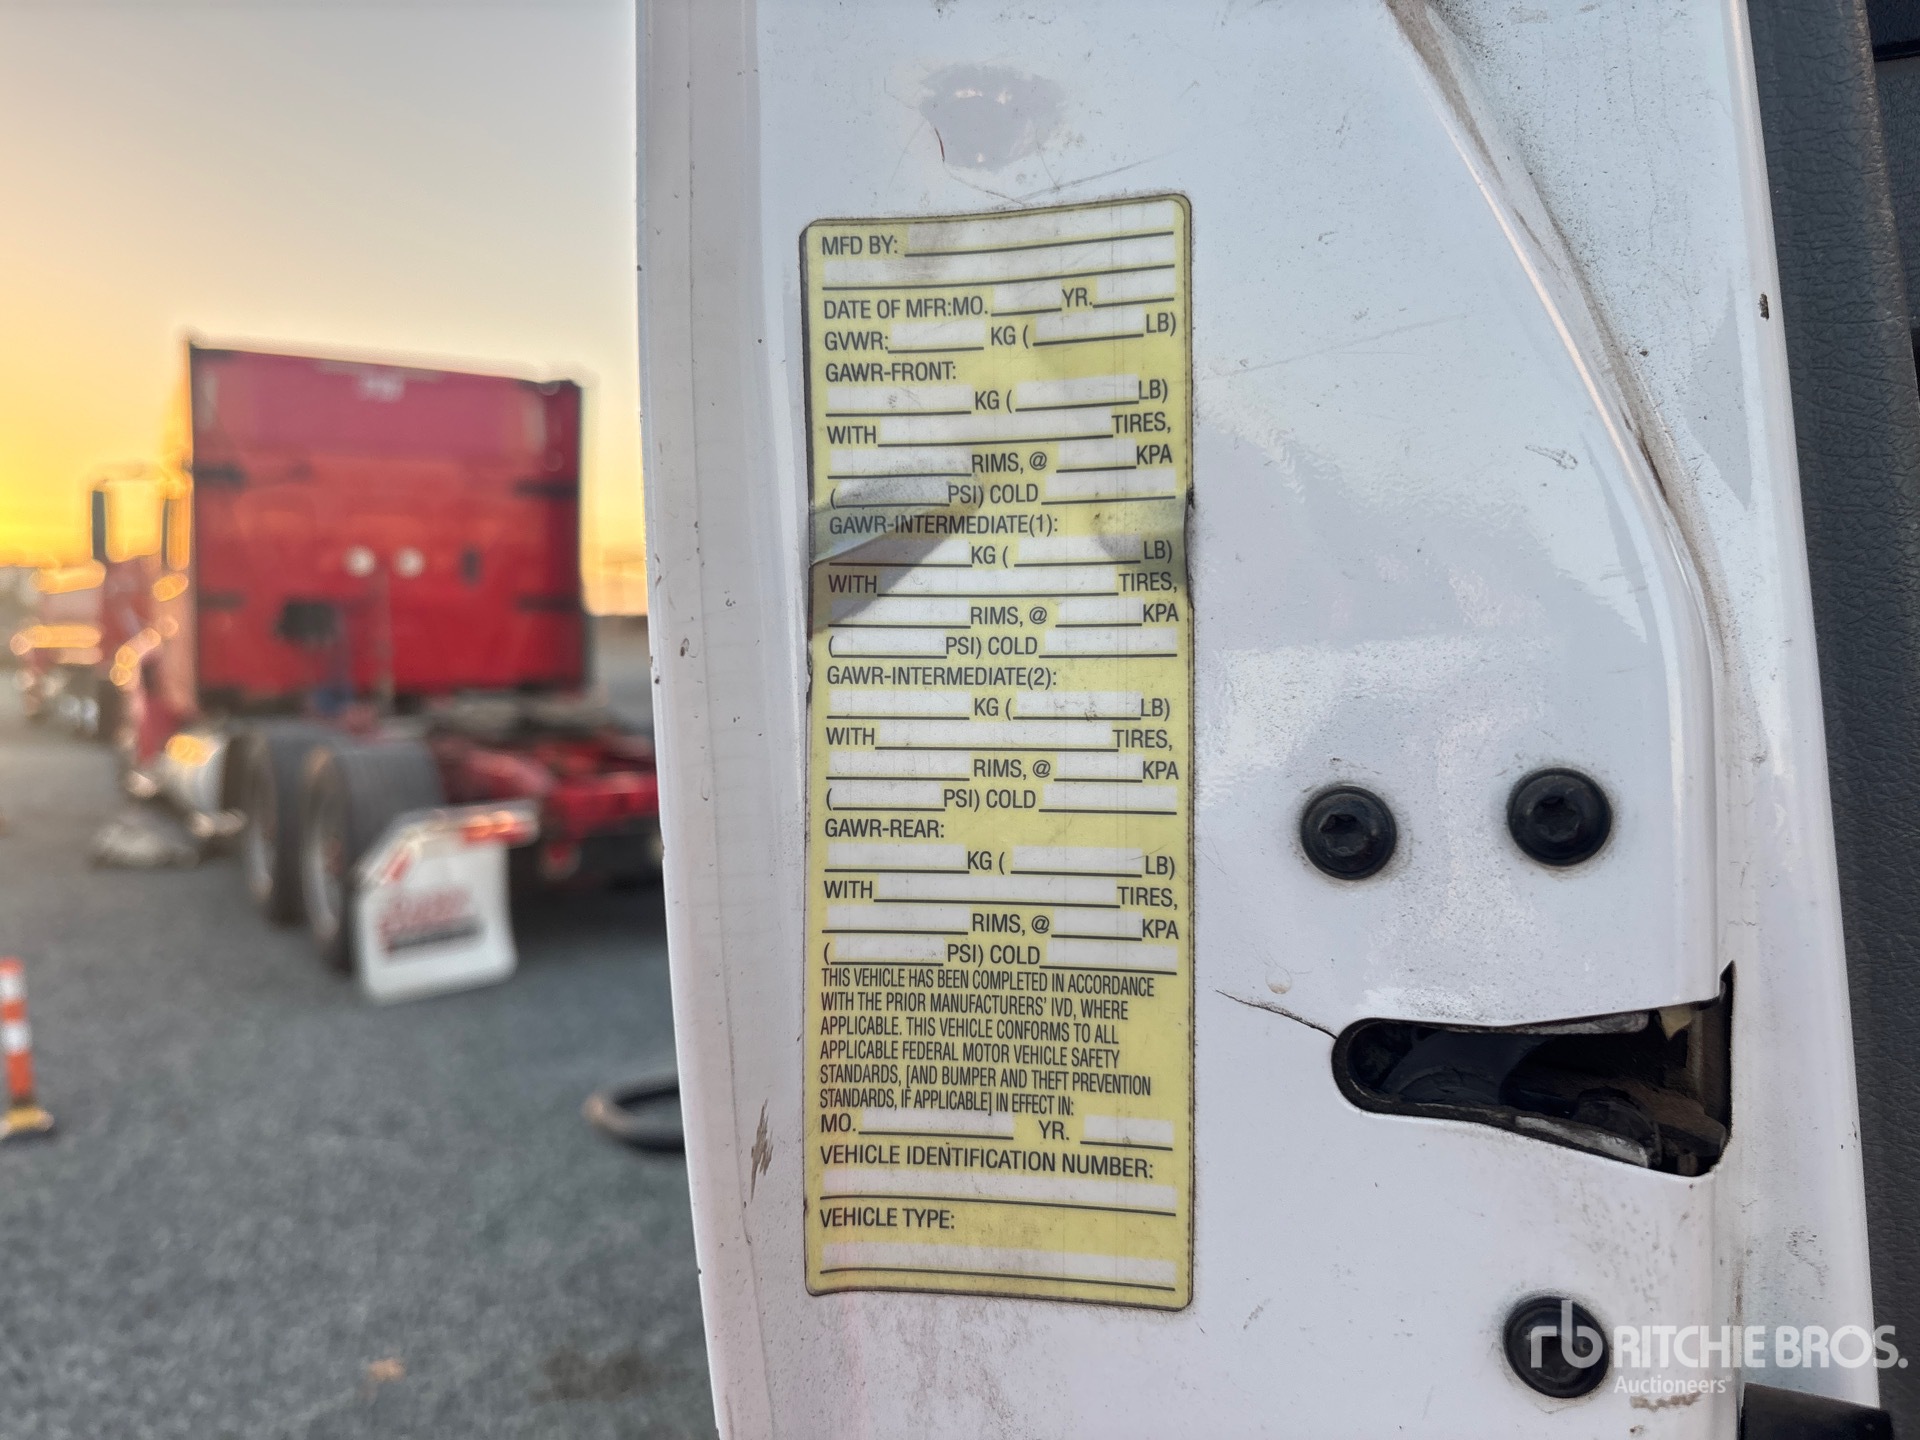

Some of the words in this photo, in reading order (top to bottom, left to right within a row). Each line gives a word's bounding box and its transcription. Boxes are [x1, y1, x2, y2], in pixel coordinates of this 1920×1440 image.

[822, 236, 863, 255] MFD
[869, 235, 898, 253] BY:
[824, 300, 871, 319] DATE
[877, 299, 901, 317] OF
[1062, 288, 1092, 307] YR.
[824, 332, 888, 350] GVWR:
[991, 326, 1016, 345] KG
[1146, 313, 1177, 337] LB)
[825, 361, 957, 382] GAWR-FRONT:
[975, 391, 1000, 410] KG
[1138, 379, 1168, 402] LB)
[827, 426, 876, 445] WITH
[1112, 413, 1171, 435] TIRES,
[972, 453, 1024, 475] RIMS,
[1029, 452, 1048, 470] @
[1136, 445, 1172, 465] KPA
[948, 485, 984, 507] PSI)
[990, 484, 1039, 503] COLD
[829, 514, 1058, 538] GAWR-INTERMEDIATE(1):
[971, 546, 995, 564] KG
[1143, 540, 1173, 562] LB)
[828, 575, 877, 593] WITH
[1119, 573, 1177, 595] TIRES,
[971, 606, 1023, 628] RIMS,
[1029, 606, 1048, 624] @
[1142, 603, 1179, 622] KPA
[946, 636, 982, 658] PSI)
[988, 636, 1038, 655] COLD
[827, 666, 1057, 689] GAWR-INTERMEDIATE(2):
[974, 698, 999, 717] KG
[1140, 698, 1170, 720] LB)
[826, 727, 875, 746] WITH
[1113, 729, 1173, 751] TIRES,
[974, 759, 1027, 781] RIMS,
[1032, 759, 1051, 778] @
[1142, 761, 1179, 780] KPA
[944, 789, 980, 811] PSI)
[986, 789, 1036, 809] COLD
[825, 818, 944, 838] GAWR-REAR:
[967, 851, 992, 870] KG
[1145, 856, 1175, 879] LB)
[824, 880, 873, 899] WITH
[1117, 886, 1178, 909] TIRES,
[972, 914, 1026, 937] RIMS,
[1031, 915, 1050, 934] @
[1142, 919, 1179, 939] KPA
[947, 944, 984, 967] PSI)
[990, 946, 1040, 965] COLD
[822, 968, 851, 986] THIS
[854, 968, 905, 987] VEHICLE
[909, 969, 934, 988] HAS
[937, 970, 969, 988] BEEN
[972, 971, 1048, 992] COMPLETED
[1051, 974, 1064, 993] IN
[1067, 974, 1155, 997] ACCORDANCE
[821, 993, 854, 1011] WITH
[858, 993, 882, 1011] THE
[886, 994, 927, 1012] PRIOR
[1050, 998, 1076, 1020] IVD,
[1080, 1000, 1128, 1020] WHERE
[820, 1017, 902, 1036] APPLICABLE.
[906, 1018, 936, 1037] THIS
[939, 1019, 993, 1038] VEHICLE
[996, 1020, 1070, 1042] CONFORMS
[1073, 1023, 1091, 1043] TO
[1094, 1024, 1119, 1044] ALL
[820, 1041, 899, 1060] APPLICABLE
[902, 1042, 958, 1061] FEDERAL
[963, 1044, 1009, 1064] MOTOR
[1013, 1046, 1068, 1066] VEHICLE
[1071, 1048, 1119, 1069] SAFETY
[820, 1065, 901, 1087] STANDARDS,
[906, 1066, 938, 1088] [AND
[942, 1067, 997, 1087] BUMPER
[1000, 1069, 1027, 1089] AND
[1031, 1070, 1069, 1090] THEFT
[1072, 1072, 1151, 1096] PREVENTION
[820, 1089, 897, 1110] STANDARDS,
[901, 1090, 911, 1108] IF
[914, 1091, 992, 1116] APPLICABLE]
[996, 1093, 1008, 1112] IN
[1012, 1093, 1055, 1114] EFFECT
[1058, 1096, 1074, 1116] IN:
[821, 1114, 856, 1133] MO.
[1039, 1120, 1070, 1140] YR.
[820, 1145, 900, 1164] VEHICLE
[907, 1145, 1056, 1172] IDENTIFICATION
[1062, 1155, 1153, 1178] NUMBER:
[820, 1208, 897, 1227] VEHICLE
[903, 1208, 954, 1229] TYPE:
